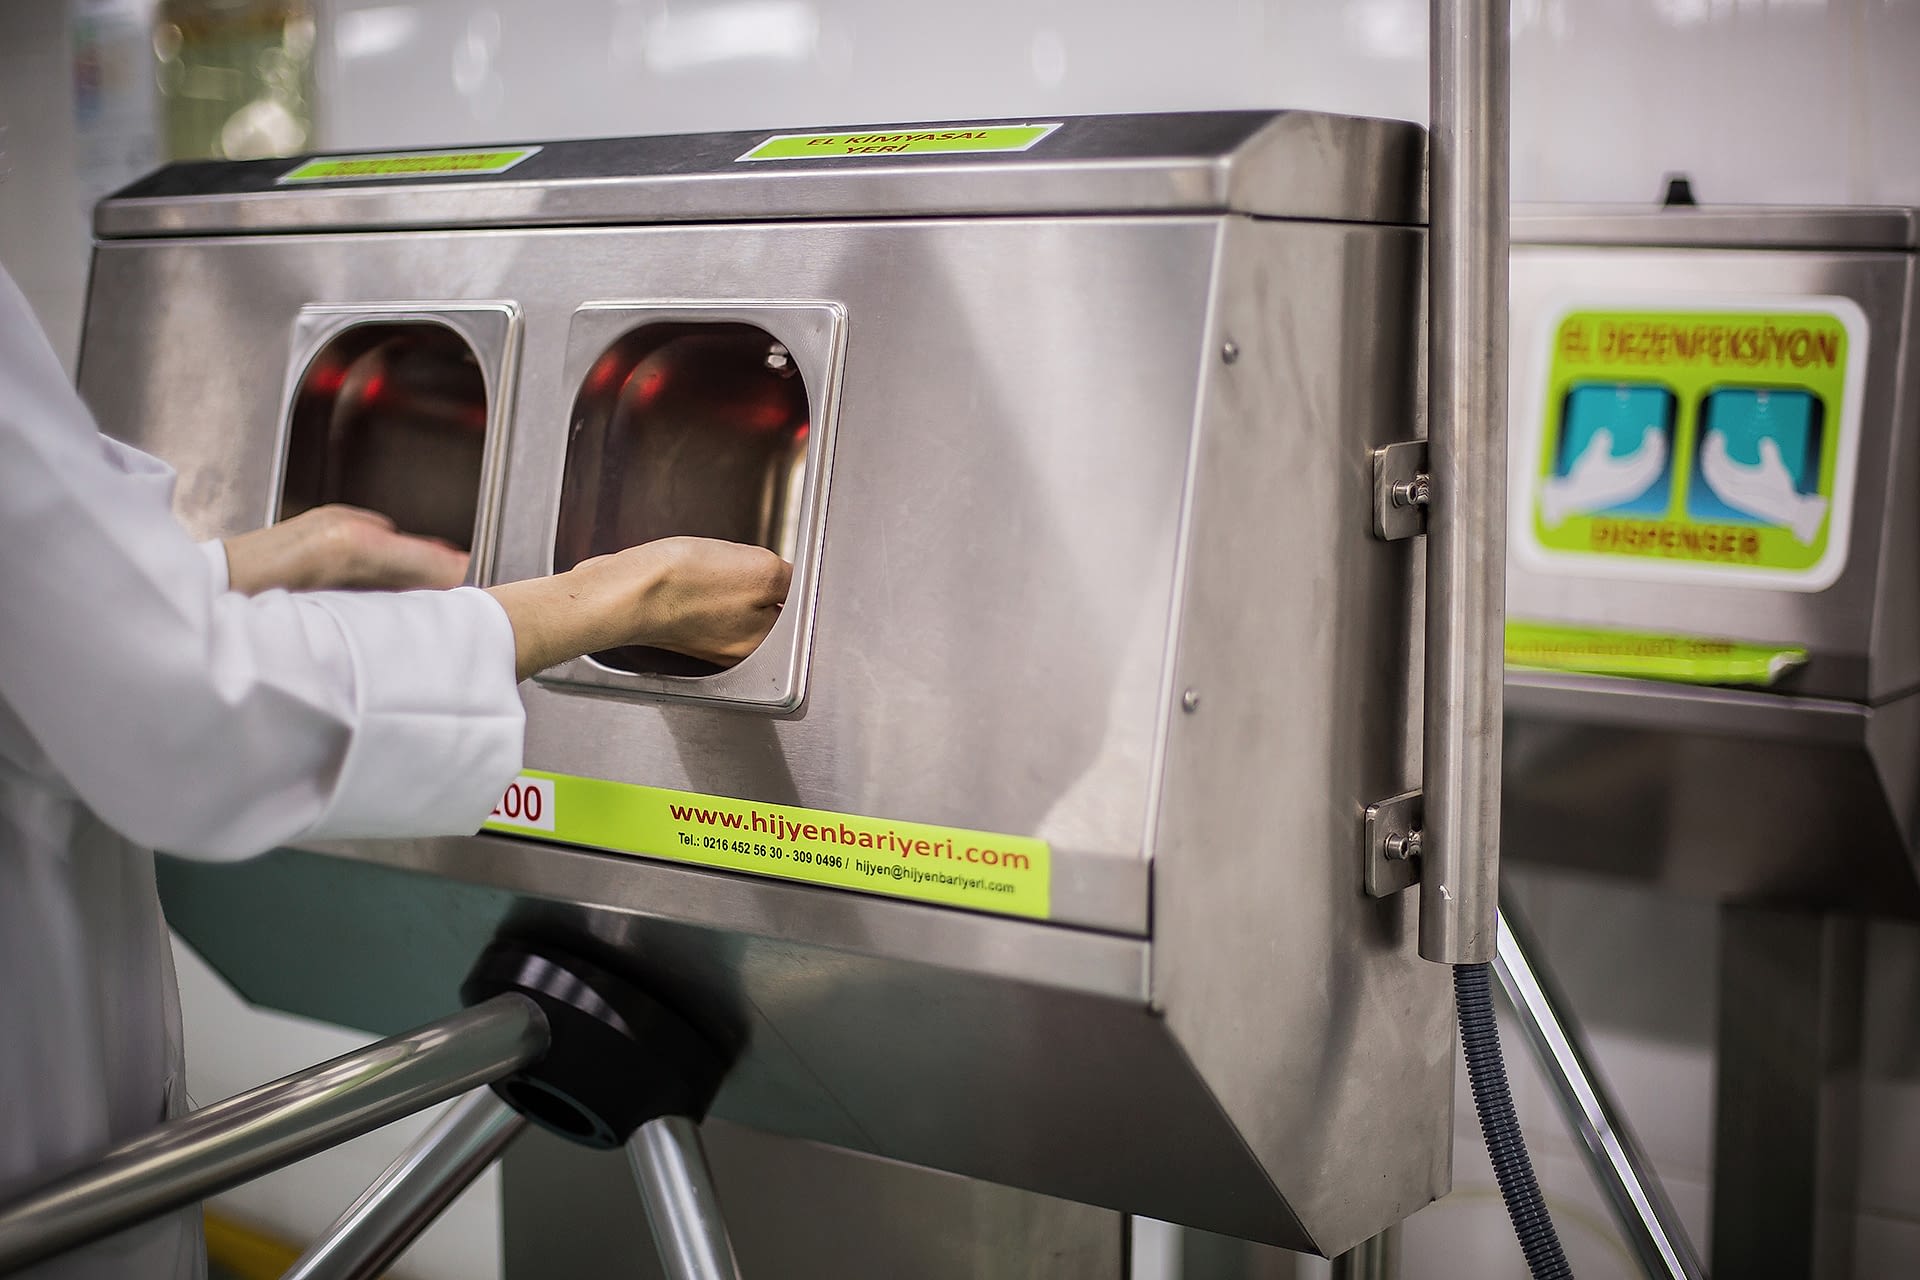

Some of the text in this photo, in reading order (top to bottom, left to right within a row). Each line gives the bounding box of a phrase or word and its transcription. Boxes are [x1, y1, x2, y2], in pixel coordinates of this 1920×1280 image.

[806, 132, 988, 146] EL KİMYASAL
[846, 143, 910, 154] YERİ
[491, 783, 541, 821] 00
[670, 805, 1030, 869] www.hijyenbariyeri.com
[678, 832, 700, 846] Tel.:
[703, 836, 729, 851] 0216
[731, 840, 751, 855] 452
[753, 845, 767, 857] 56
[769, 847, 783, 859] 30
[792, 850, 812, 863] 309
[816, 854, 843, 869] 0496
[856, 859, 1015, 893] hijyen@hijyenbariyeri.com
